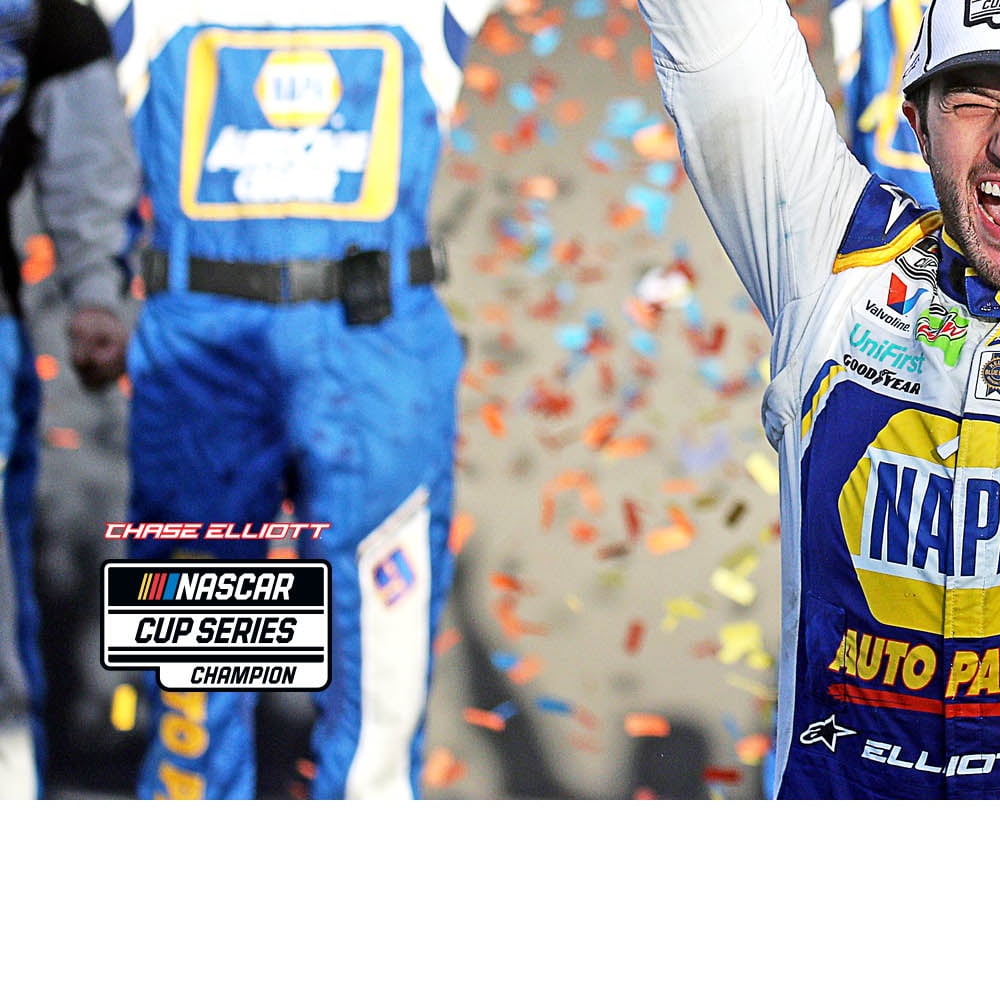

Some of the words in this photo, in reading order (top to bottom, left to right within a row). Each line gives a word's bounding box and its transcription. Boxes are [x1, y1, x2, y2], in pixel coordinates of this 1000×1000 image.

[865, 300, 910, 332] Valvoline
[850, 323, 925, 374] UniFirst
[829, 628, 937, 690] AUTO
